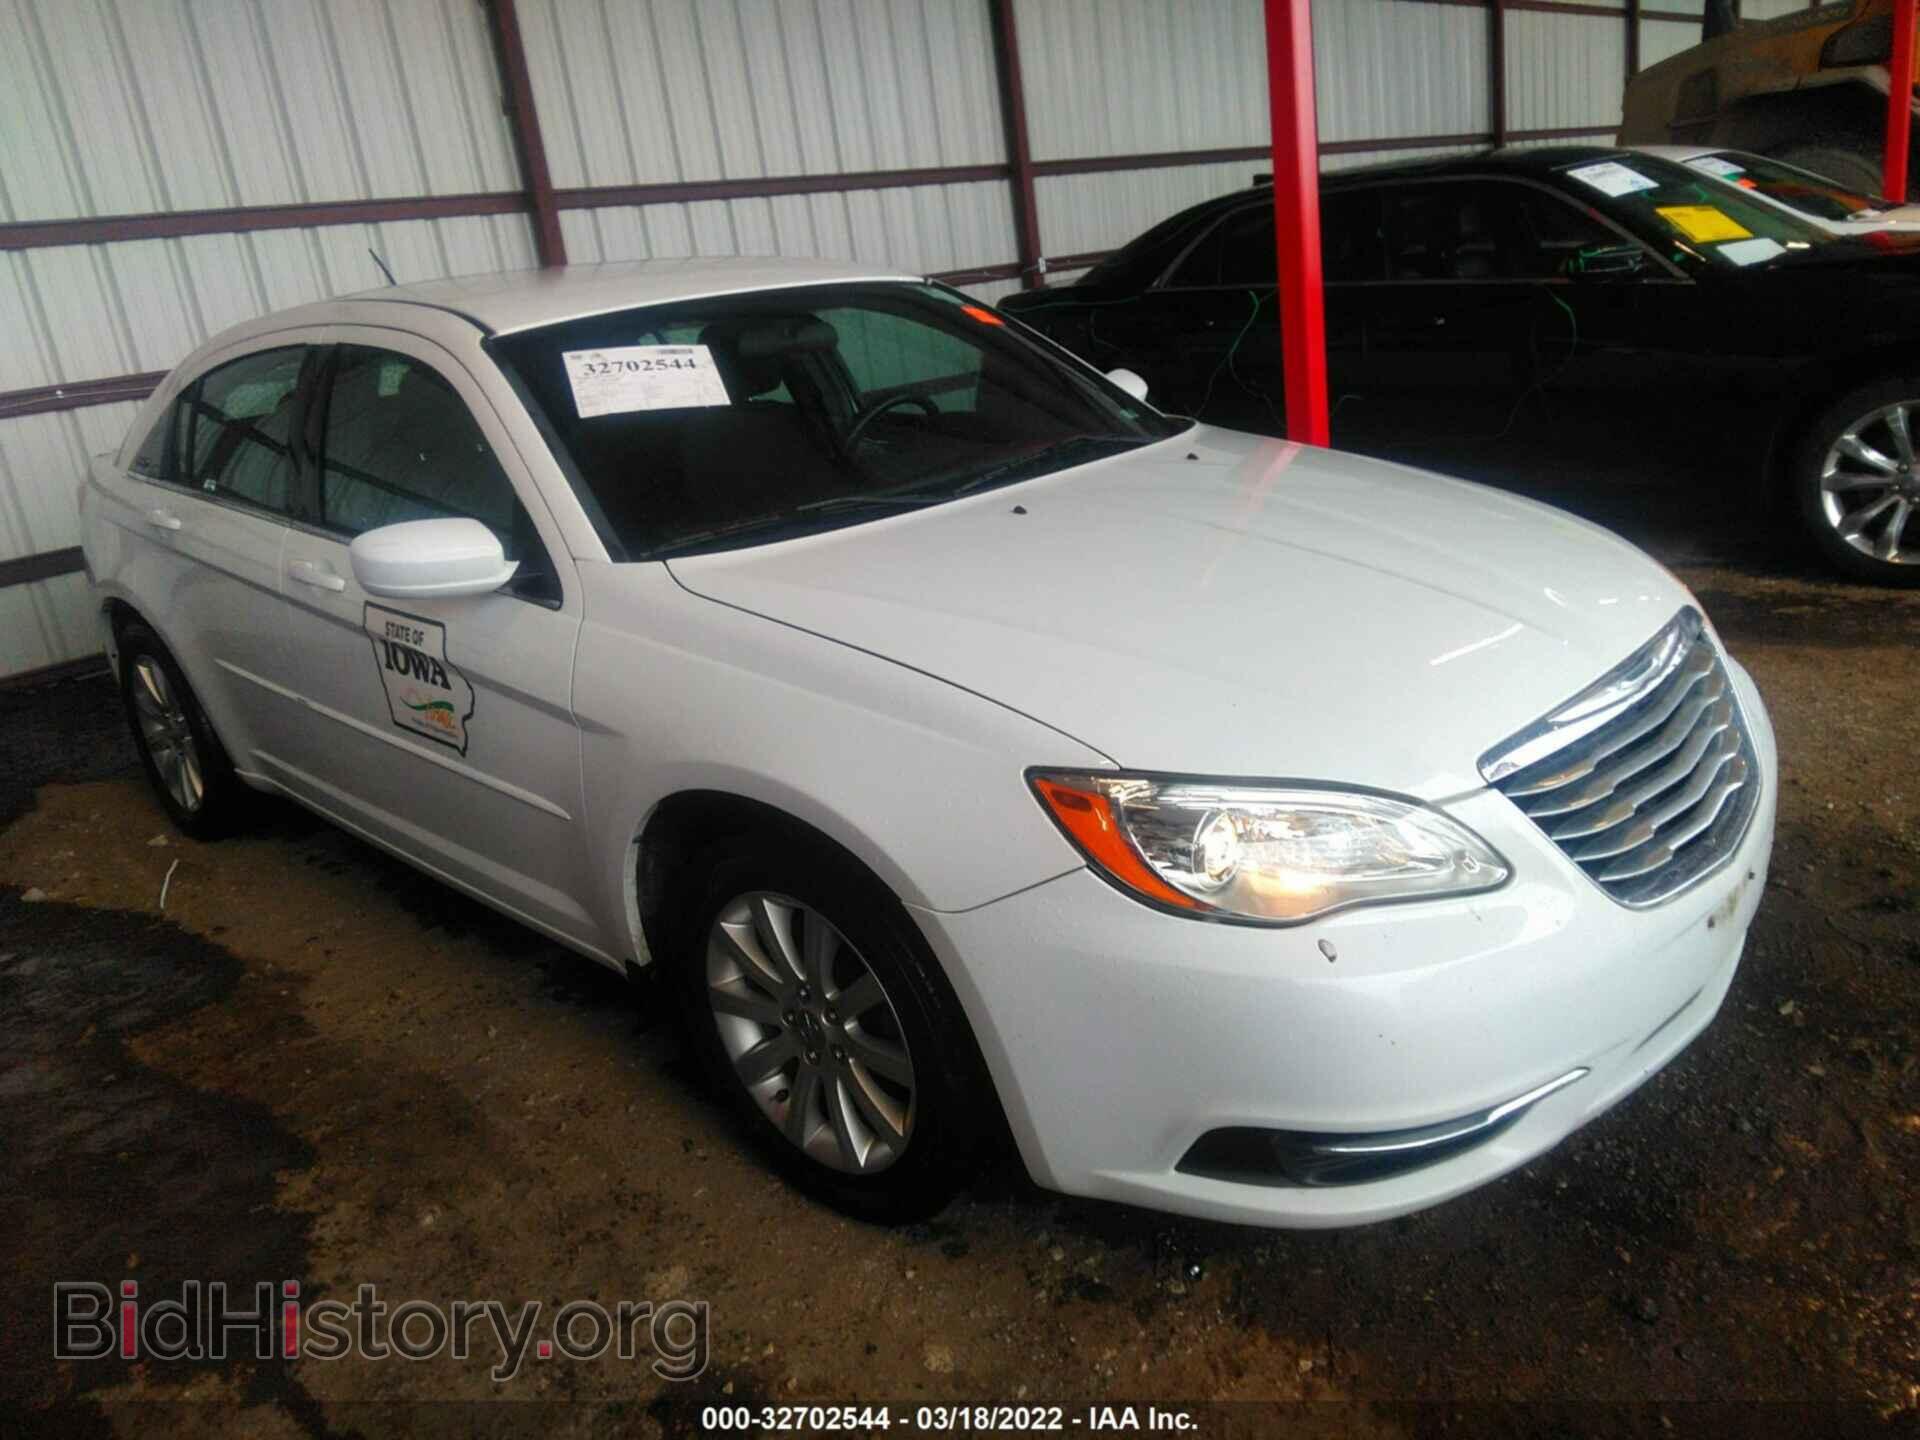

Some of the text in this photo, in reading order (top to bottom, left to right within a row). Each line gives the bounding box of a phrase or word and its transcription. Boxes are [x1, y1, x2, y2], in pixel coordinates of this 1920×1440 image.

[583, 357, 697, 376] 32702544
[384, 621, 425, 647] STATE OF
[383, 639, 452, 691] IOWA
